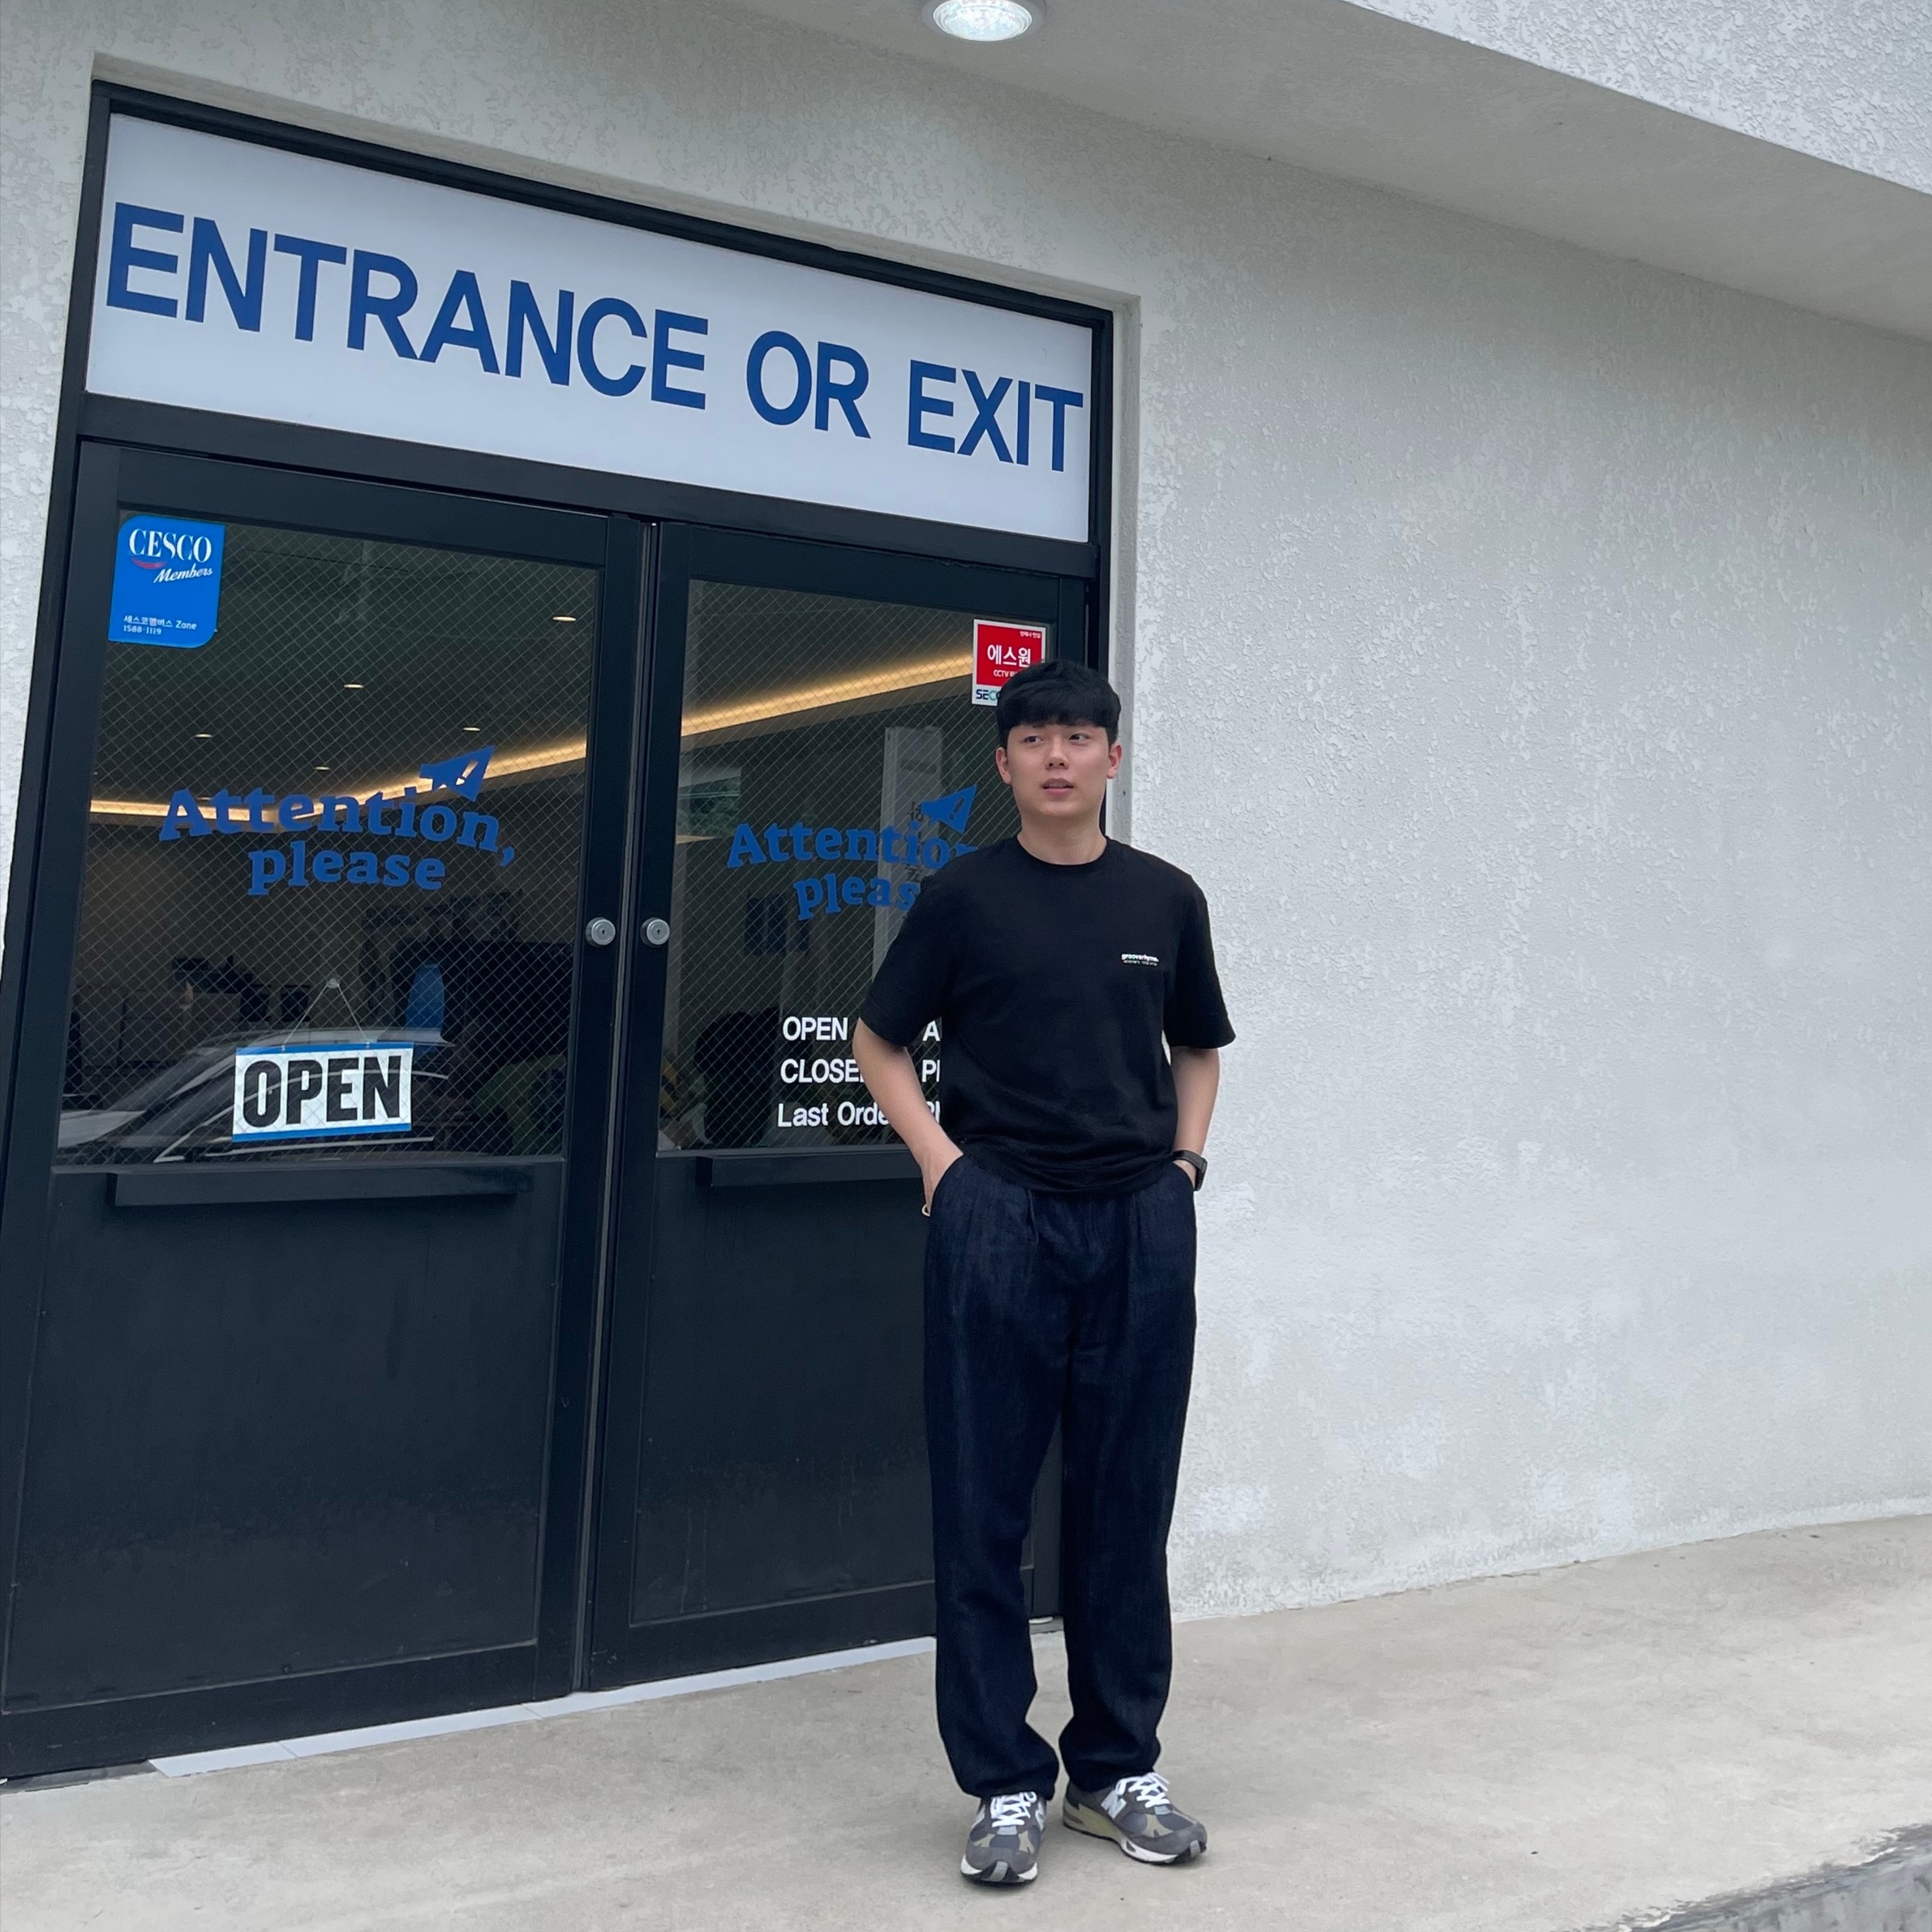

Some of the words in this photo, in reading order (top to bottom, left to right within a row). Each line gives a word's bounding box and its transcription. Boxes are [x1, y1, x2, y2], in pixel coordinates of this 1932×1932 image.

[106, 202, 708, 410] ENTRANCE
[746, 330, 871, 439] OR
[908, 359, 1084, 472] EXIT
[128, 528, 213, 564] CESCO
[152, 563, 213, 583] Members
[122, 625, 162, 635] 1588-1119
[175, 620, 198, 630] Zone
[986, 644, 1032, 668] 에스원
[993, 669, 1009, 678] CCTV
[976, 689, 1000, 702] SEC
[159, 787, 515, 867] Attention,
[247, 840, 446, 895] please
[792, 873, 921, 921] pleas
[783, 1016, 848, 1041] OPEN
[780, 1058, 865, 1084] CLOSE
[921, 1059, 940, 1083] P
[243, 1055, 402, 1128] OPEN
[777, 1102, 829, 1127] Last
[837, 1101, 891, 1127] Orde
